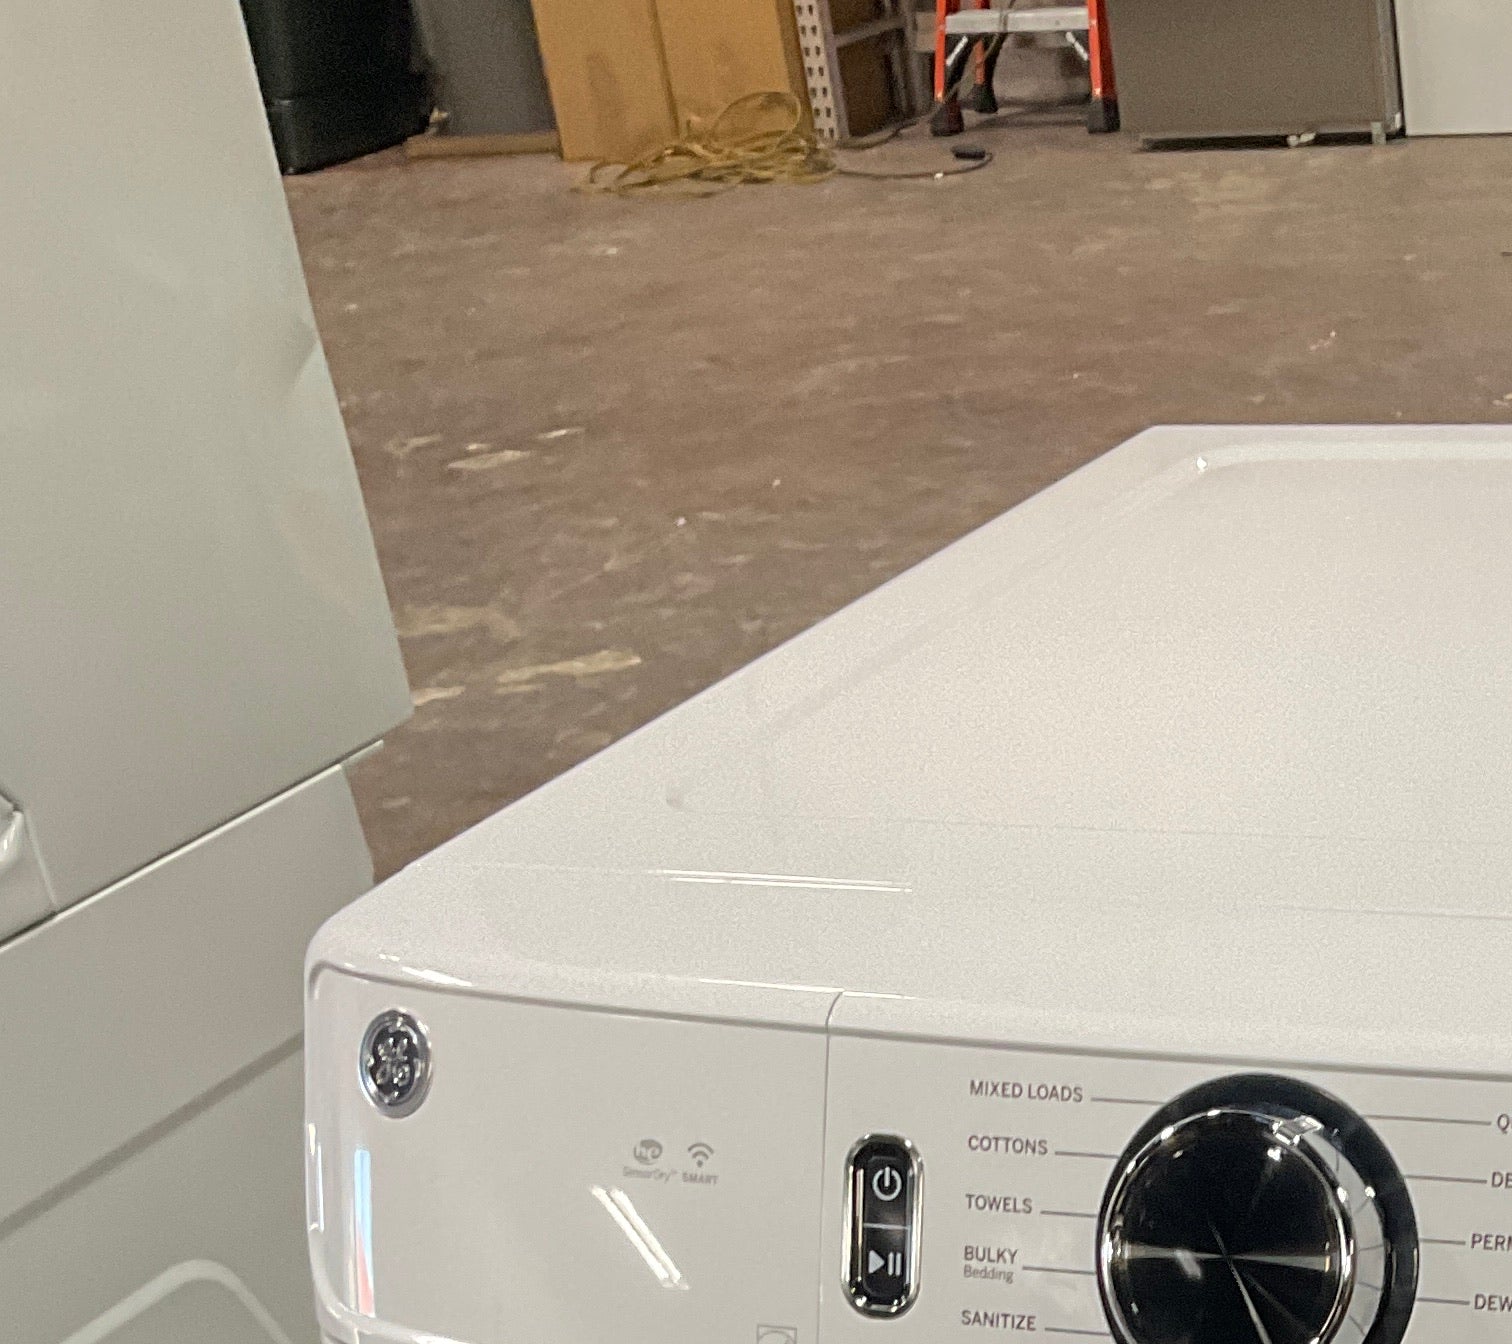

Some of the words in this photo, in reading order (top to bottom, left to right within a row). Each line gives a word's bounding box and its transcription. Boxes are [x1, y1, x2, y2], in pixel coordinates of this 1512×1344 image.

[969, 1080, 1023, 1099] MIXED
[1027, 1083, 1083, 1103] LOADS
[967, 1135, 1048, 1155] COTTONS
[965, 1193, 1033, 1214] TOWELS
[963, 1246, 1019, 1265] BULKY
[963, 1264, 1014, 1285] Bedding
[961, 1310, 1037, 1332] SANITIZE
